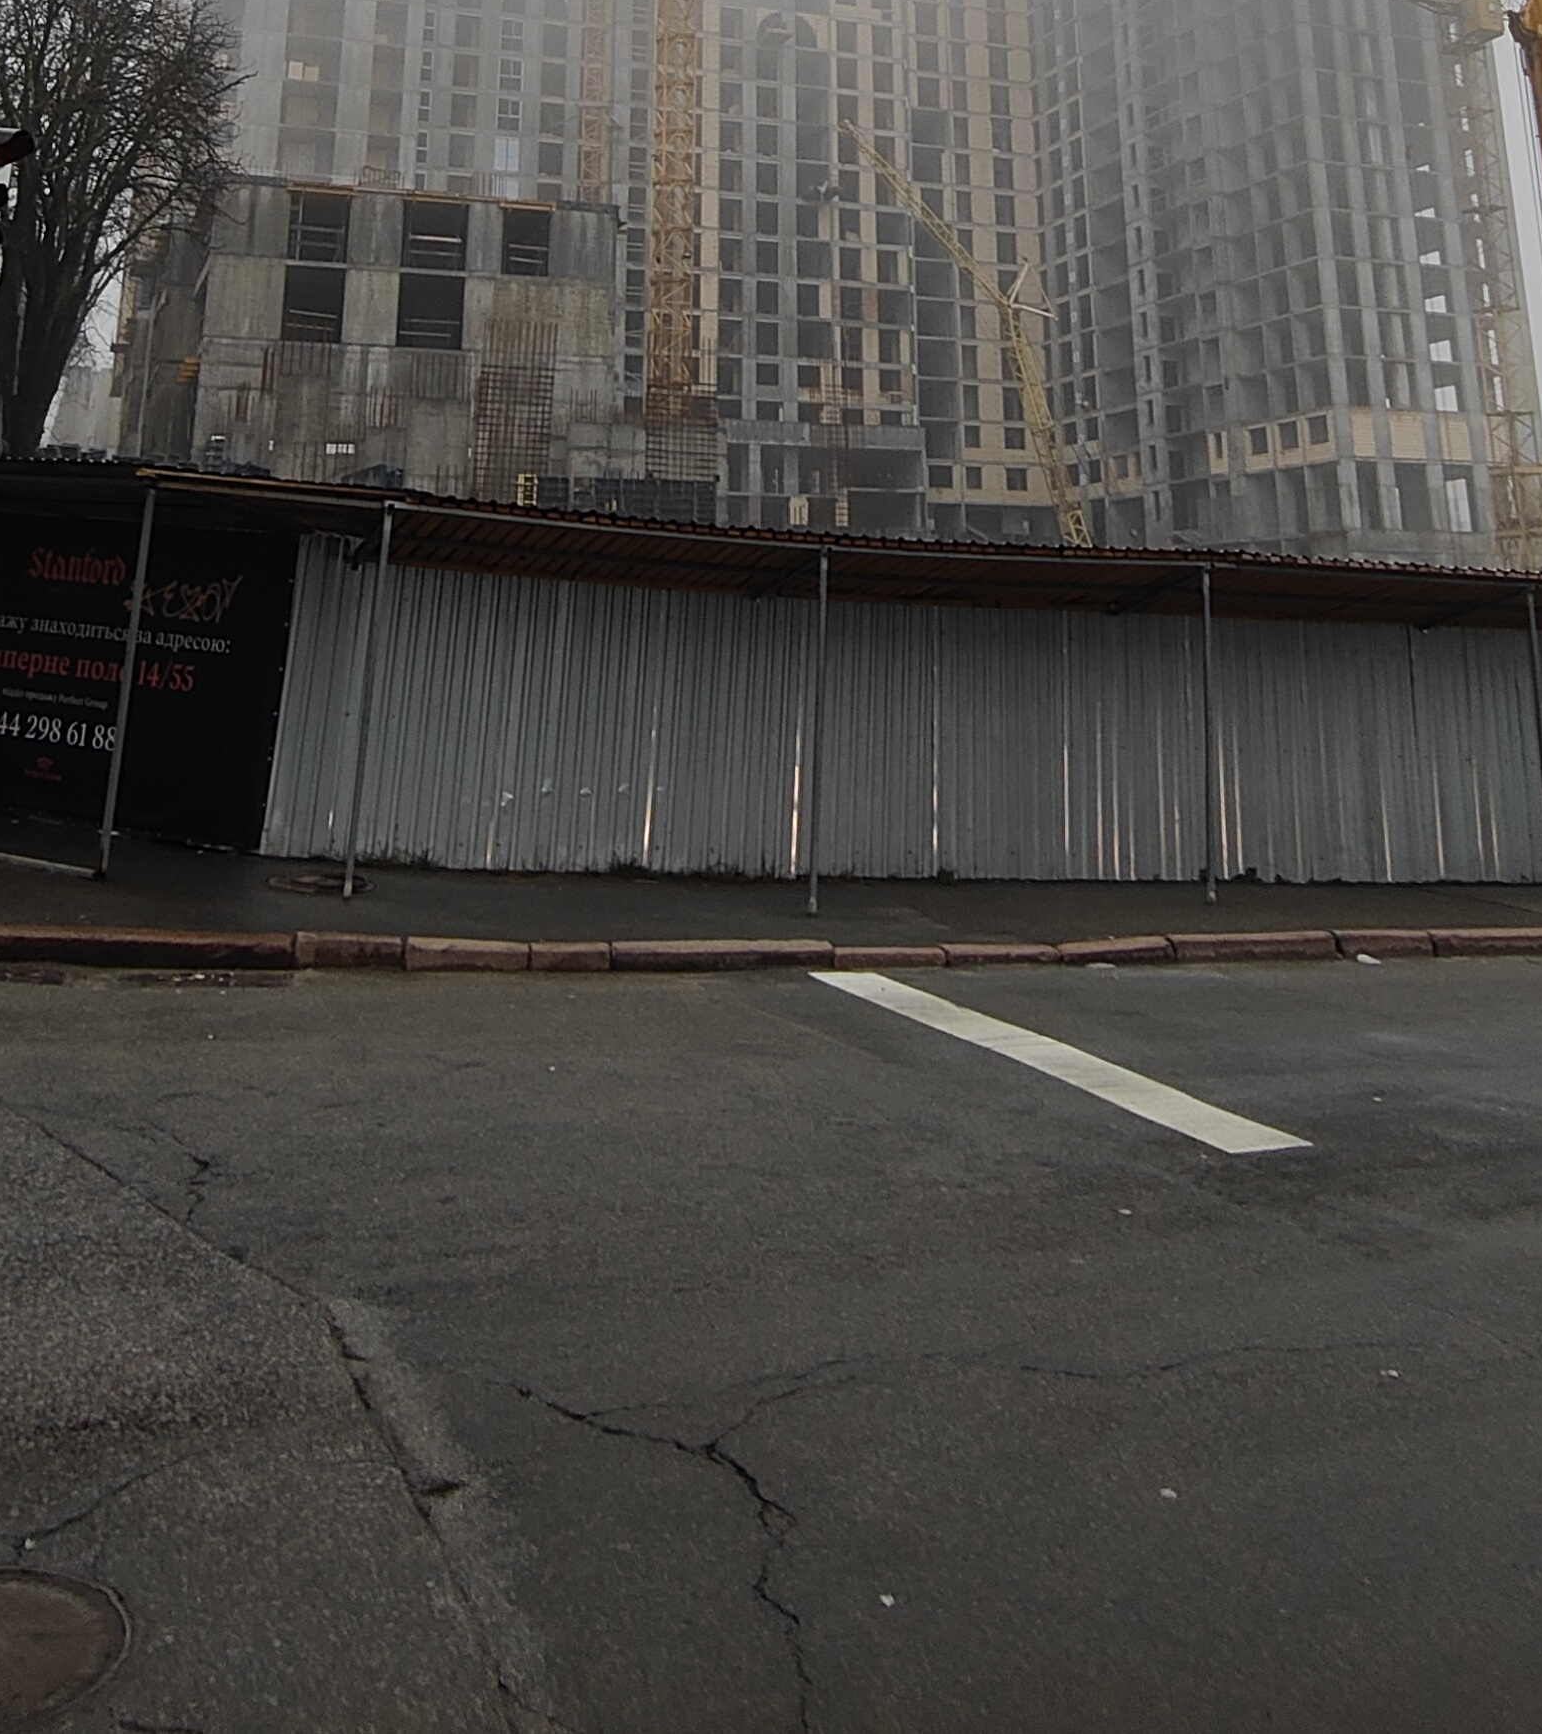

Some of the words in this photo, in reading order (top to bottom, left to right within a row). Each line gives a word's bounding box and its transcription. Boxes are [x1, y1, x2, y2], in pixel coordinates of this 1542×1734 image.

[27, 547, 127, 585] Stanford
[30, 616, 131, 643] знаходиться
[136, 629, 153, 645] за
[155, 631, 232, 655] адресою:
[137, 659, 197, 694] 14/55
[24, 714, 63, 744] 298
[66, 720, 88, 748] 61
[92, 723, 118, 752] 88
